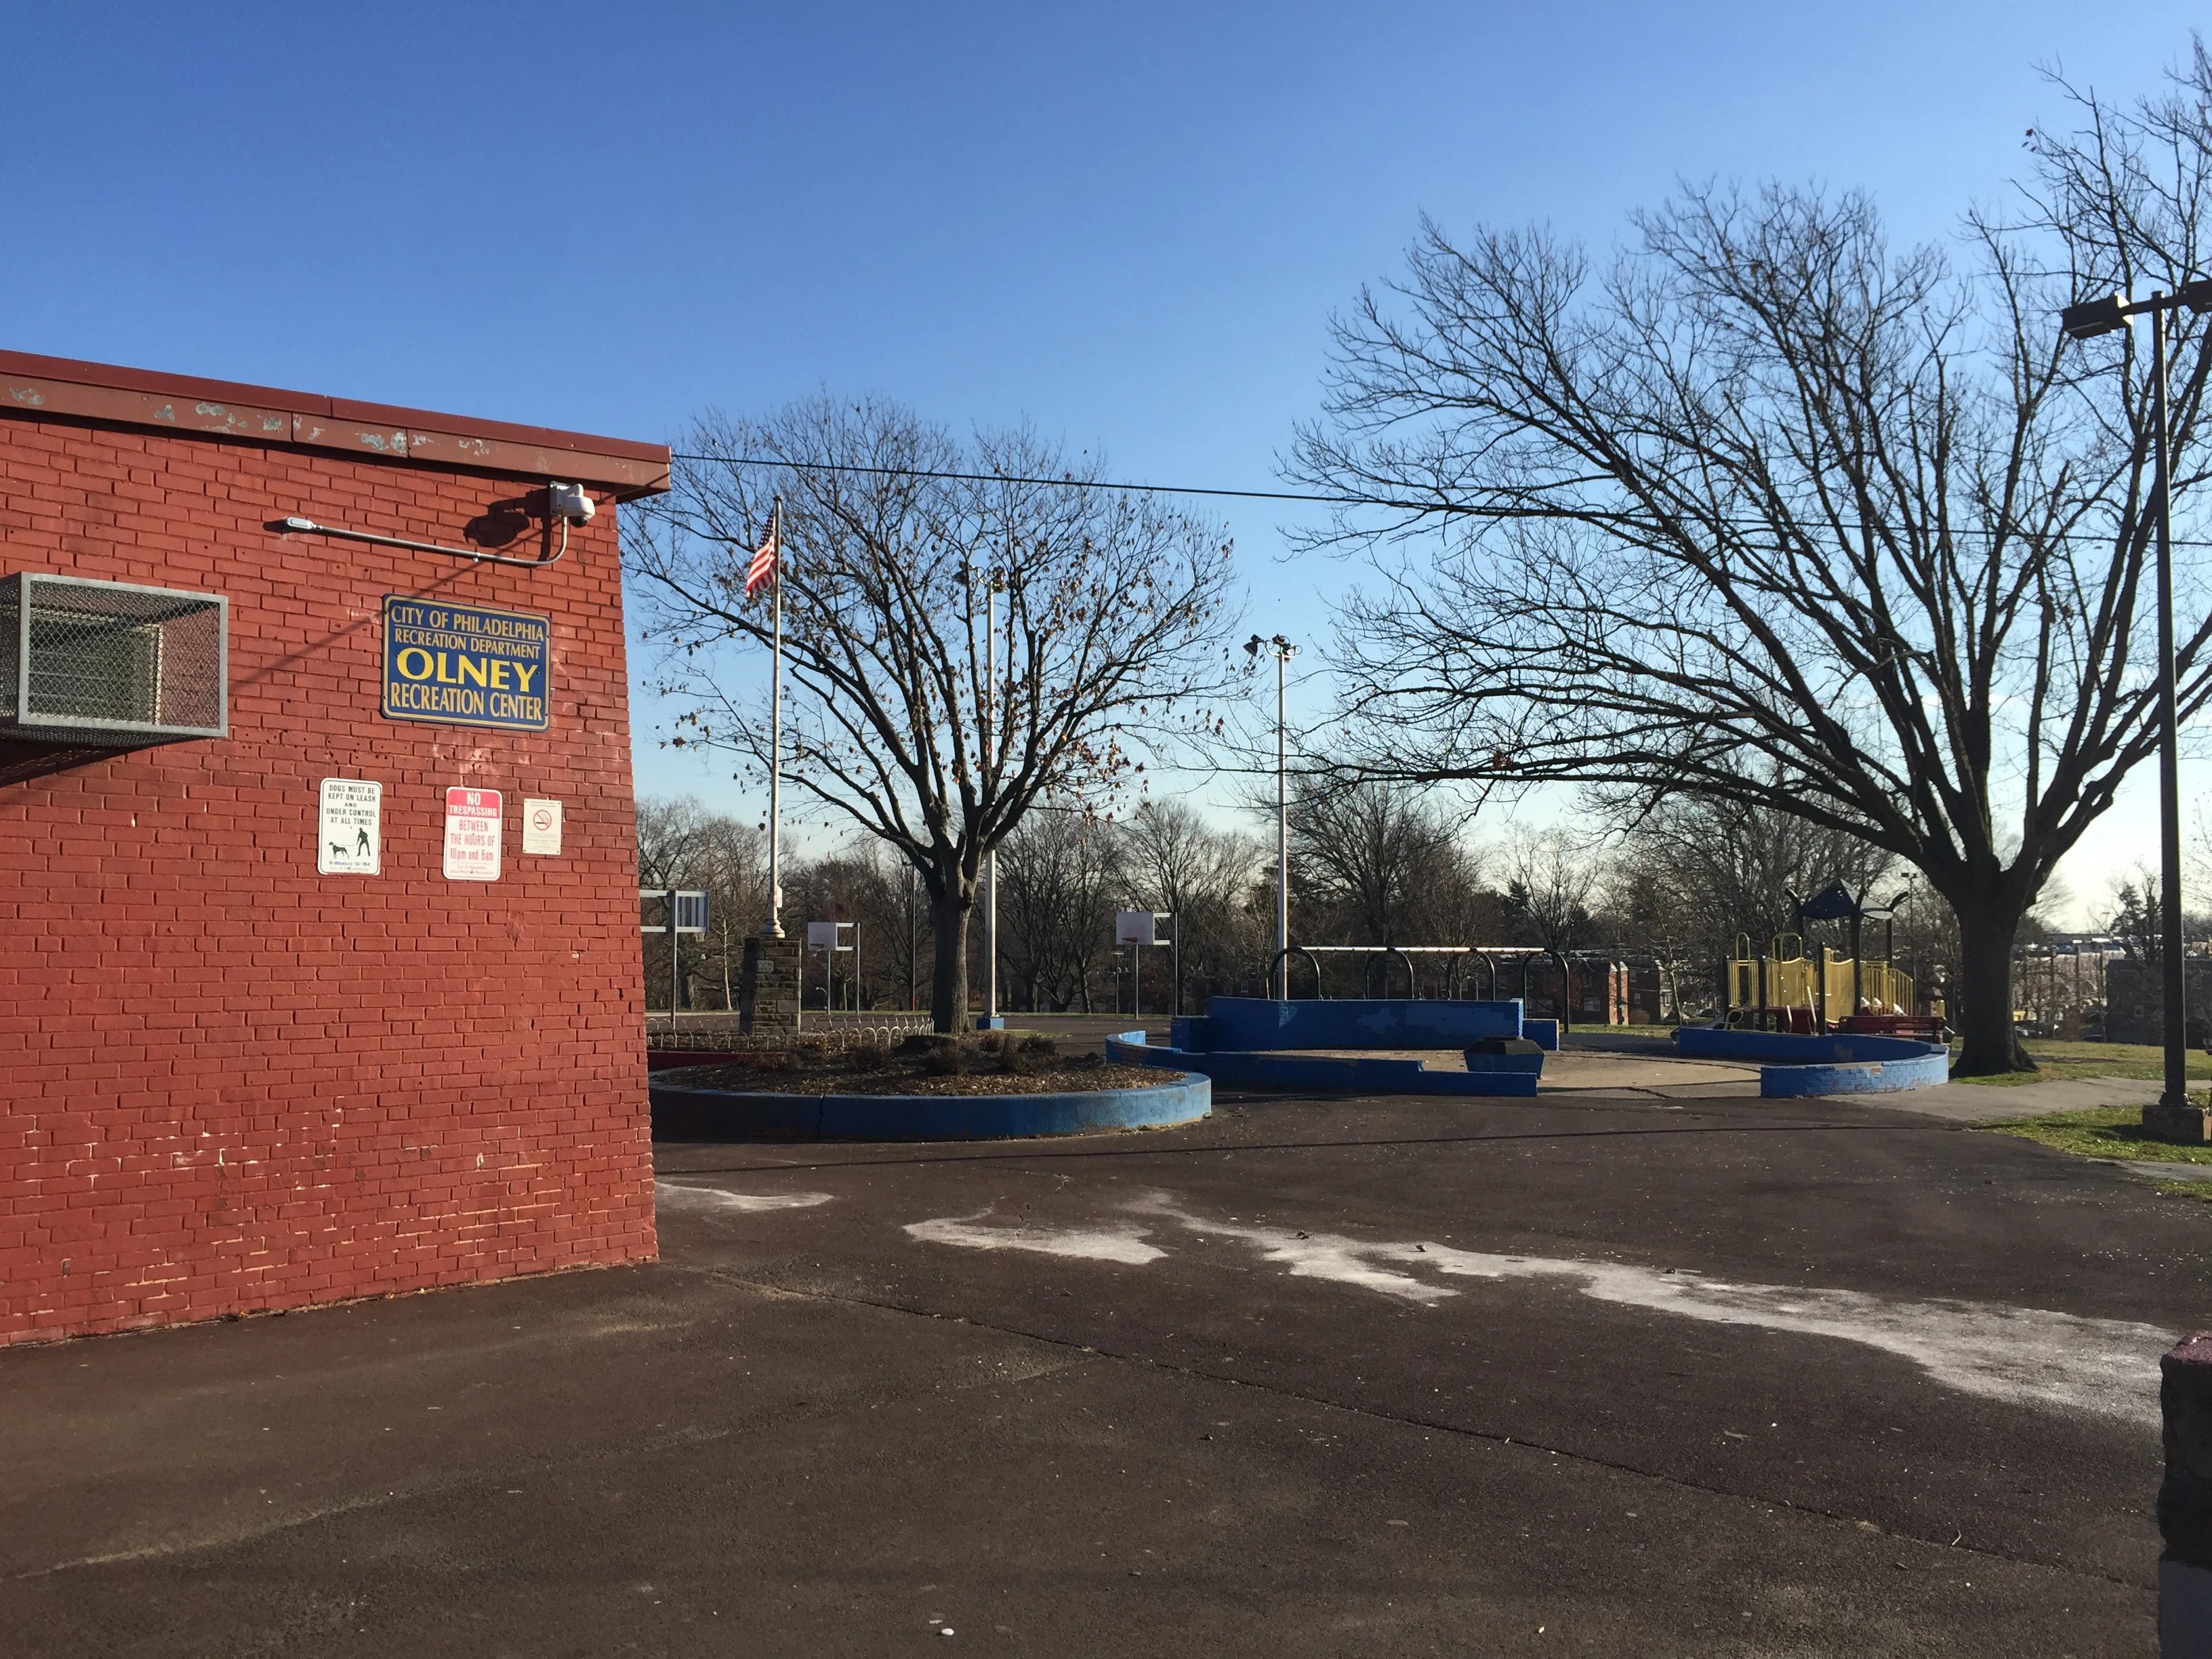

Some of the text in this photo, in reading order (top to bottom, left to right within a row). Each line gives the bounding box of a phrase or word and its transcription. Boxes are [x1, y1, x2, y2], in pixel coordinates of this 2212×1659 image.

[391, 606, 544, 640] CITY OF PHILADELPHIA
[395, 628, 541, 659] RECREATION DEPARTMENT
[396, 647, 538, 693] OLNEY
[391, 682, 542, 720] RECREATION CENTER
[329, 784, 345, 792] DOGS
[467, 792, 480, 804] NO
[449, 805, 497, 817] TRESPASSING
[459, 820, 488, 832] BETWEEN
[451, 834, 495, 846] THE HOURS OF
[450, 848, 493, 861] 10pm and 6am
